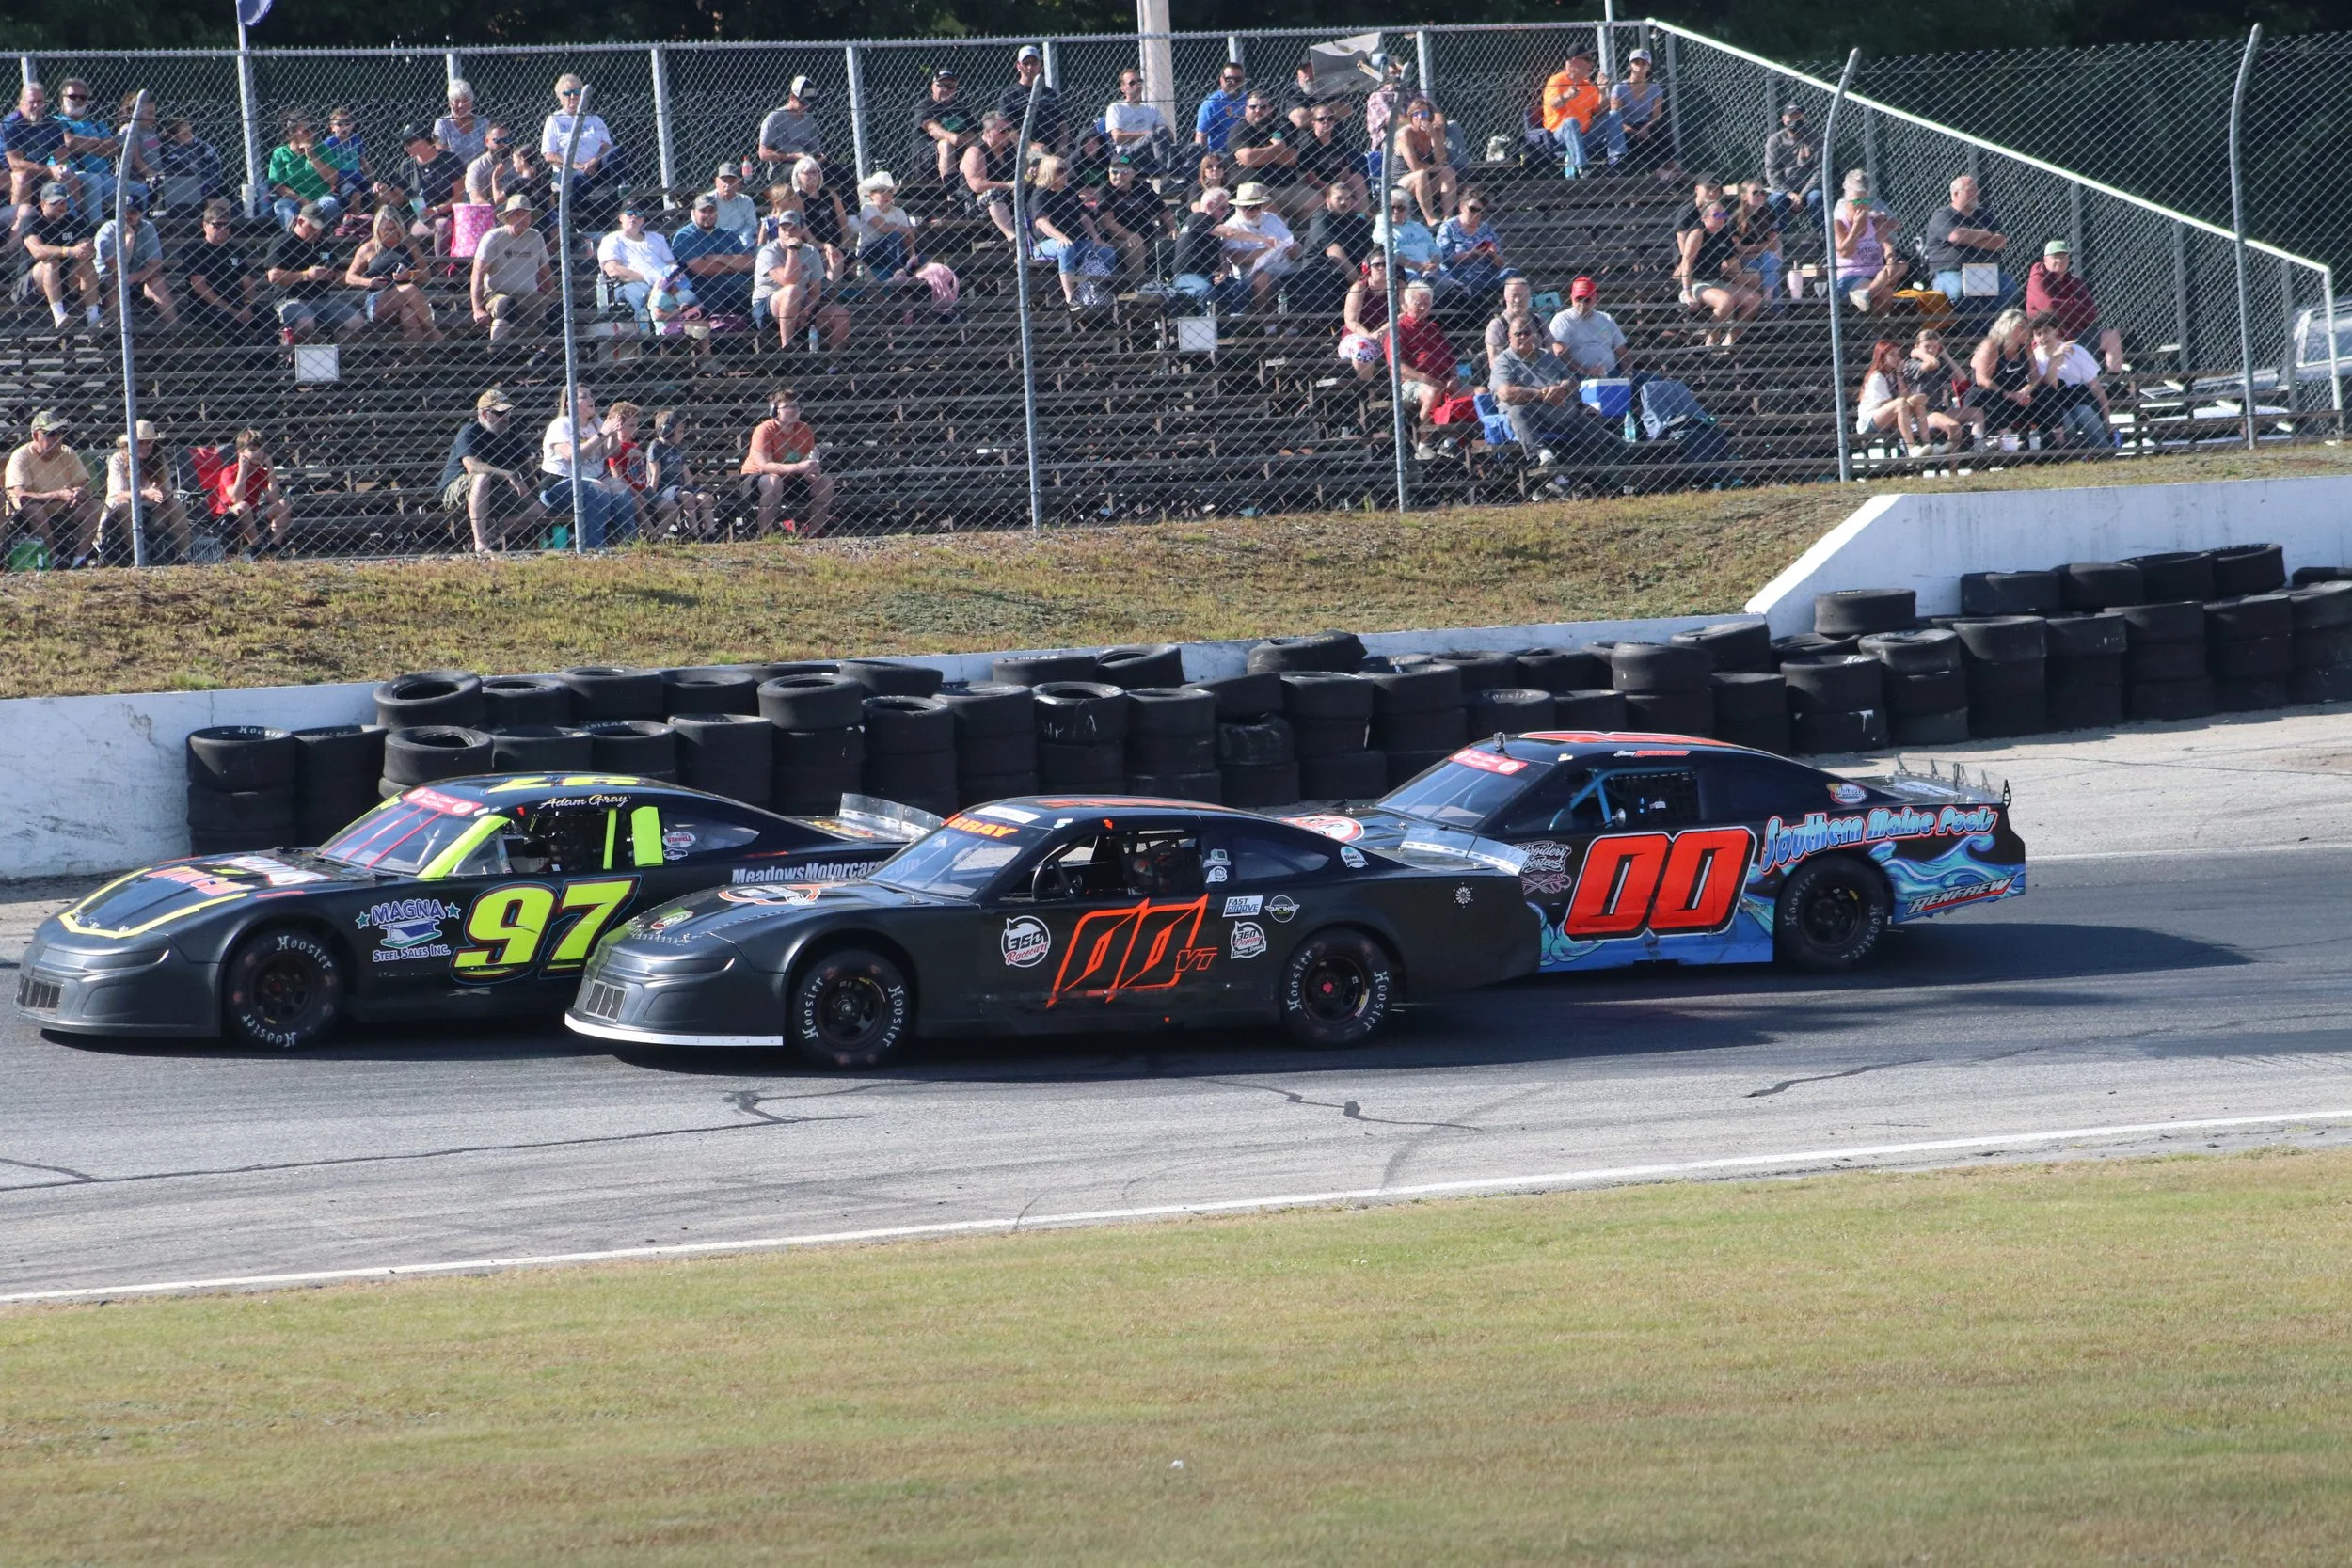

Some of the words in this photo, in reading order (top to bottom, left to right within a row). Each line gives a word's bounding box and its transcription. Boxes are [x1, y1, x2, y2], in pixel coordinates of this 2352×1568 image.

[538, 797, 586, 810] Adam
[588, 794, 628, 808] Gray
[948, 816, 1019, 838] GRAY
[1760, 813, 1866, 875] Southern
[1865, 806, 1937, 843] Maine
[1936, 806, 1999, 836] Pools
[1564, 826, 1757, 942] 00
[1905, 876, 2014, 916] RENFREW
[371, 898, 446, 926] MAGNA
[1226, 904, 1259, 912] GROOVE
[451, 874, 644, 985] 97
[1009, 930, 1044, 951] 360
[1236, 929, 1256, 941] 360
[276, 935, 333, 969] Hoosier
[1175, 947, 1218, 973] VT
[1287, 949, 1313, 1011] Hoosier
[802, 976, 823, 1039] Hoosier
[882, 985, 904, 1047] Hoosier
[1363, 971, 1390, 1032] Hoosier
[242, 1014, 297, 1047] Hoosier
